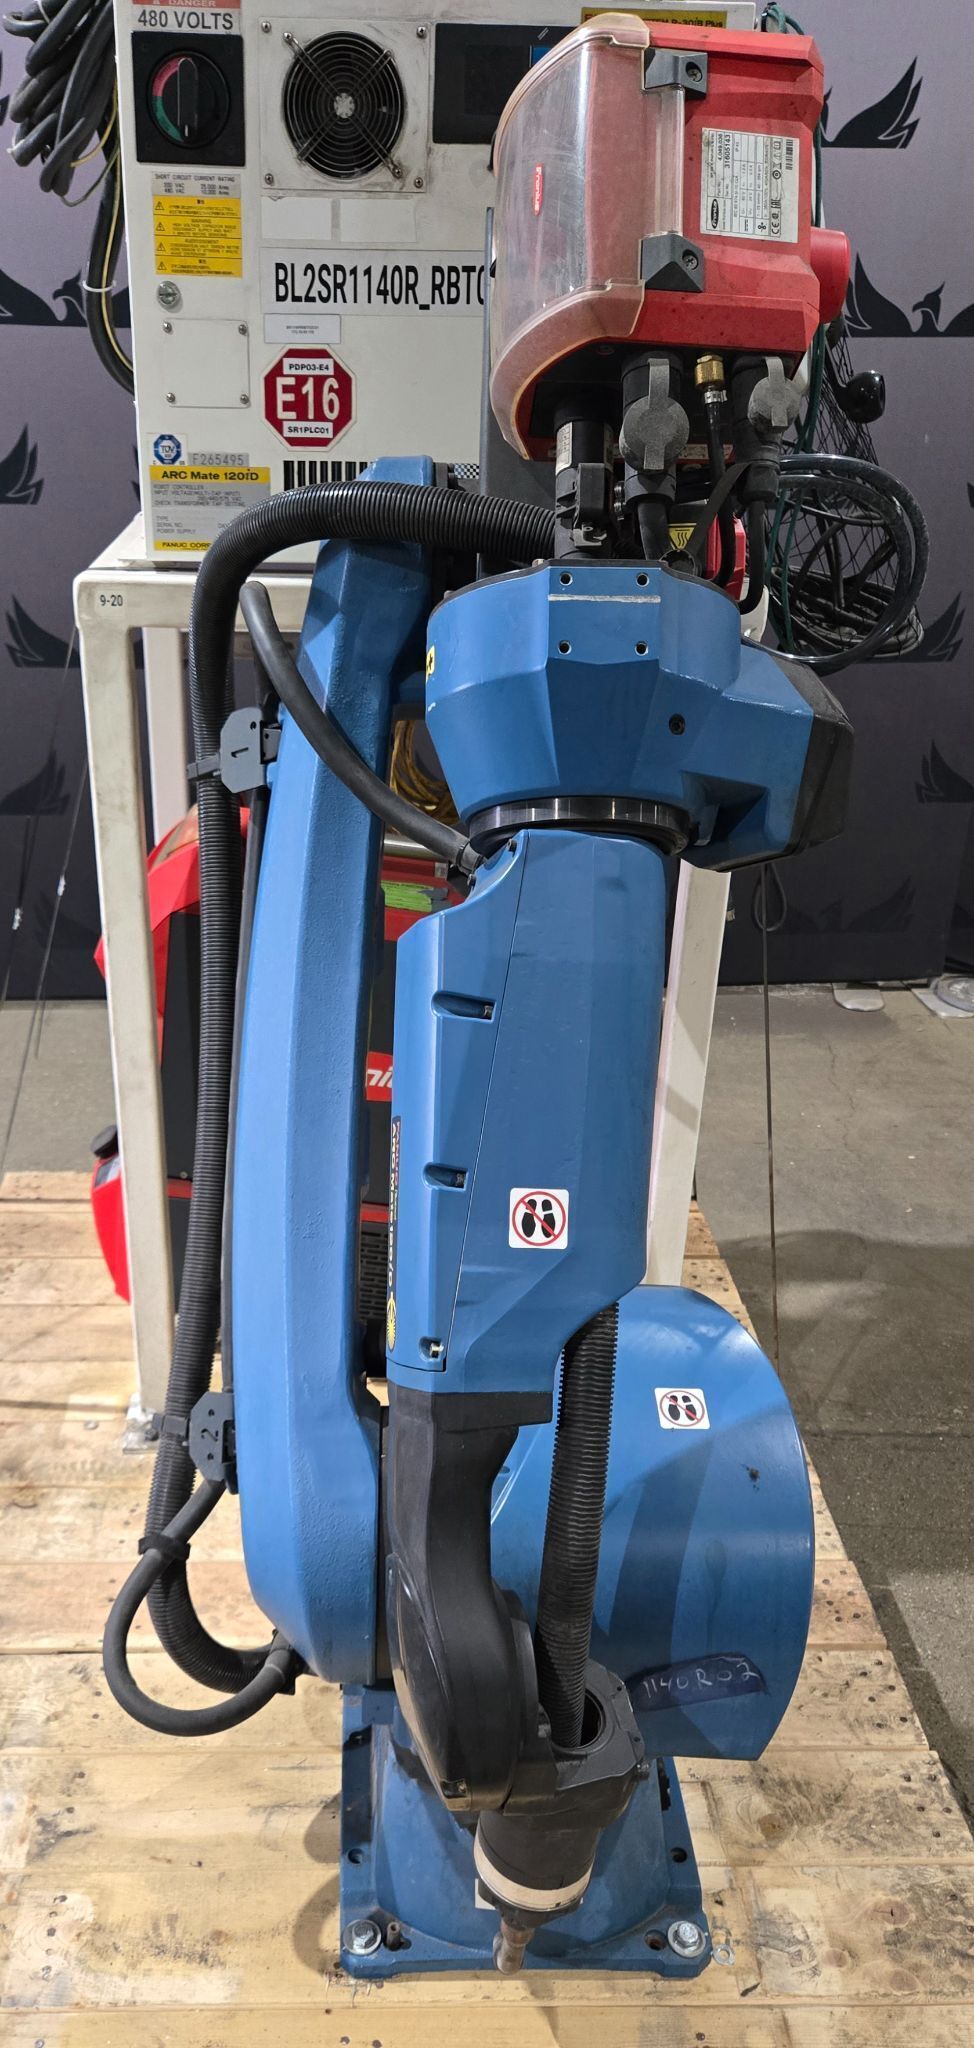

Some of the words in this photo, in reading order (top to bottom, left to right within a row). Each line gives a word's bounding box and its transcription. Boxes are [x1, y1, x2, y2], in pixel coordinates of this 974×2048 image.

[138, 9, 168, 28] 480
[174, 11, 234, 30] VOLTS
[288, 363, 329, 371] PDP03-E4
[276, 377, 340, 420] E16
[287, 425, 329, 434] SR1PLC01
[192, 453, 244, 465] F265495
[162, 470, 188, 480] ARC
[191, 471, 220, 480] Mate
[224, 468, 259, 481] 120iD
[100, 594, 123, 607] 9-20
